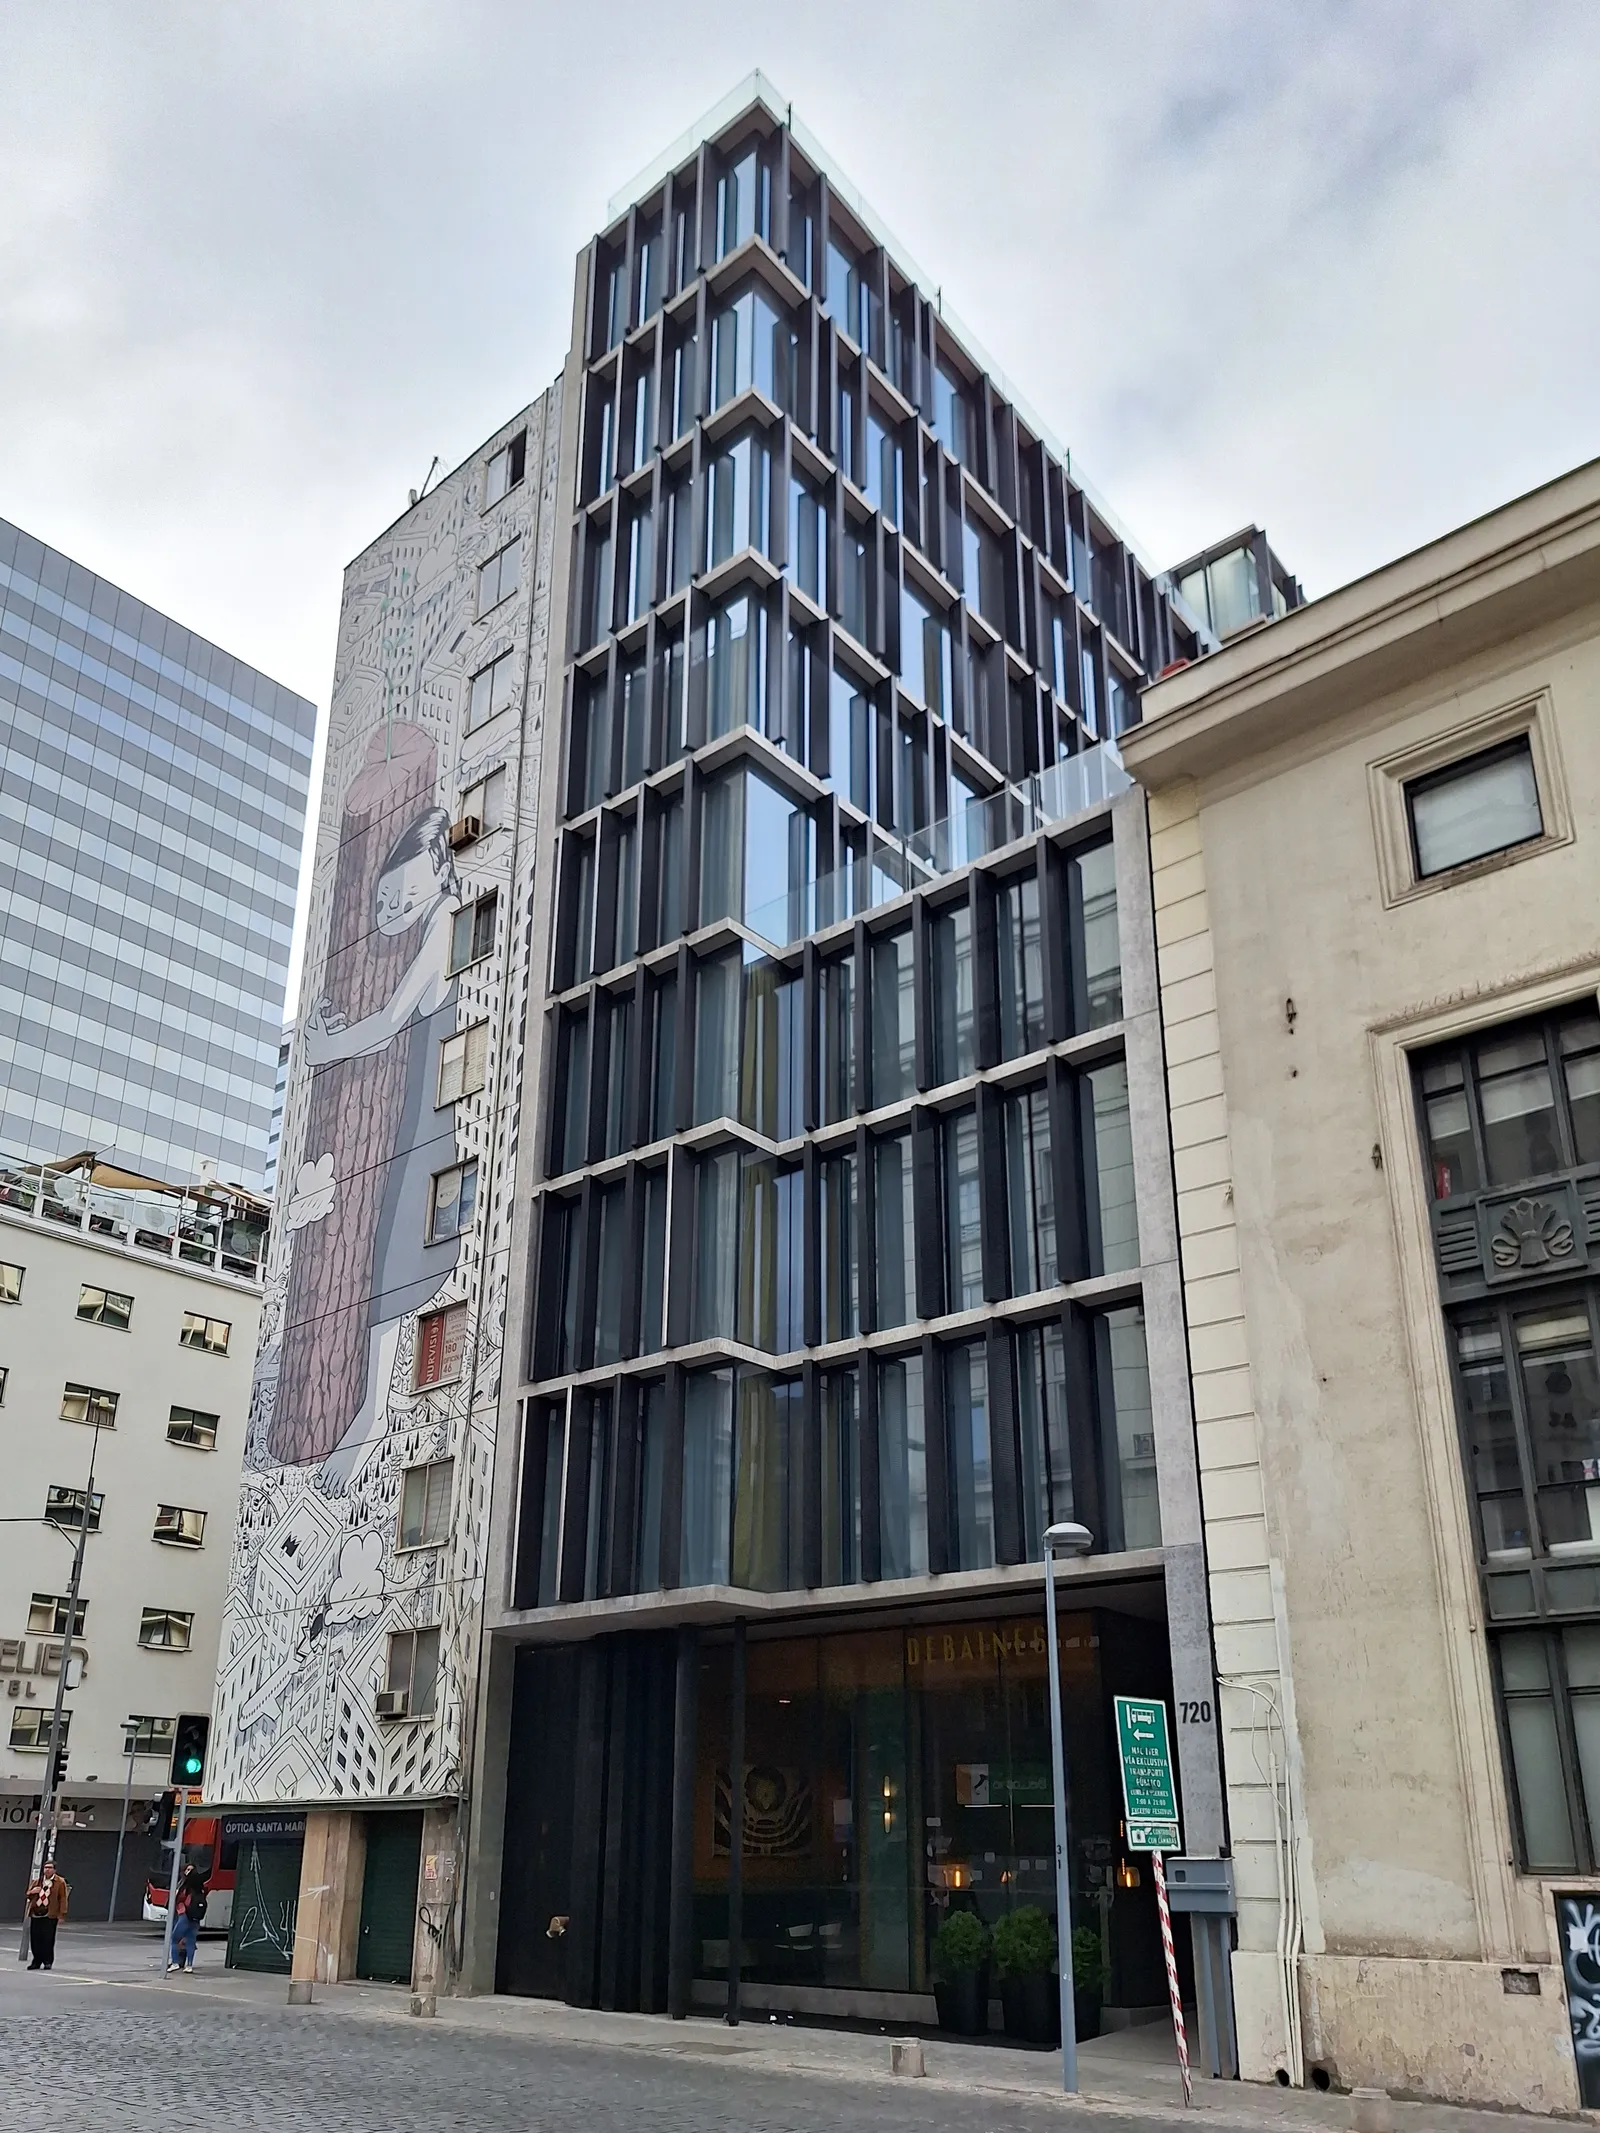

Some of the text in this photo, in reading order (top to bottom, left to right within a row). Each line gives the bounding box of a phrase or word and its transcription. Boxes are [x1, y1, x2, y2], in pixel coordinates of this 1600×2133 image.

[445, 1342, 457, 1354] 180
[0, 1680, 37, 1697] EL
[1179, 1700, 1212, 1724] 720
[1136, 1757, 1168, 1767] EXCLUSIVA
[225, 1821, 255, 1833] ÓPTICA
[256, 1821, 283, 1833] SANTA
